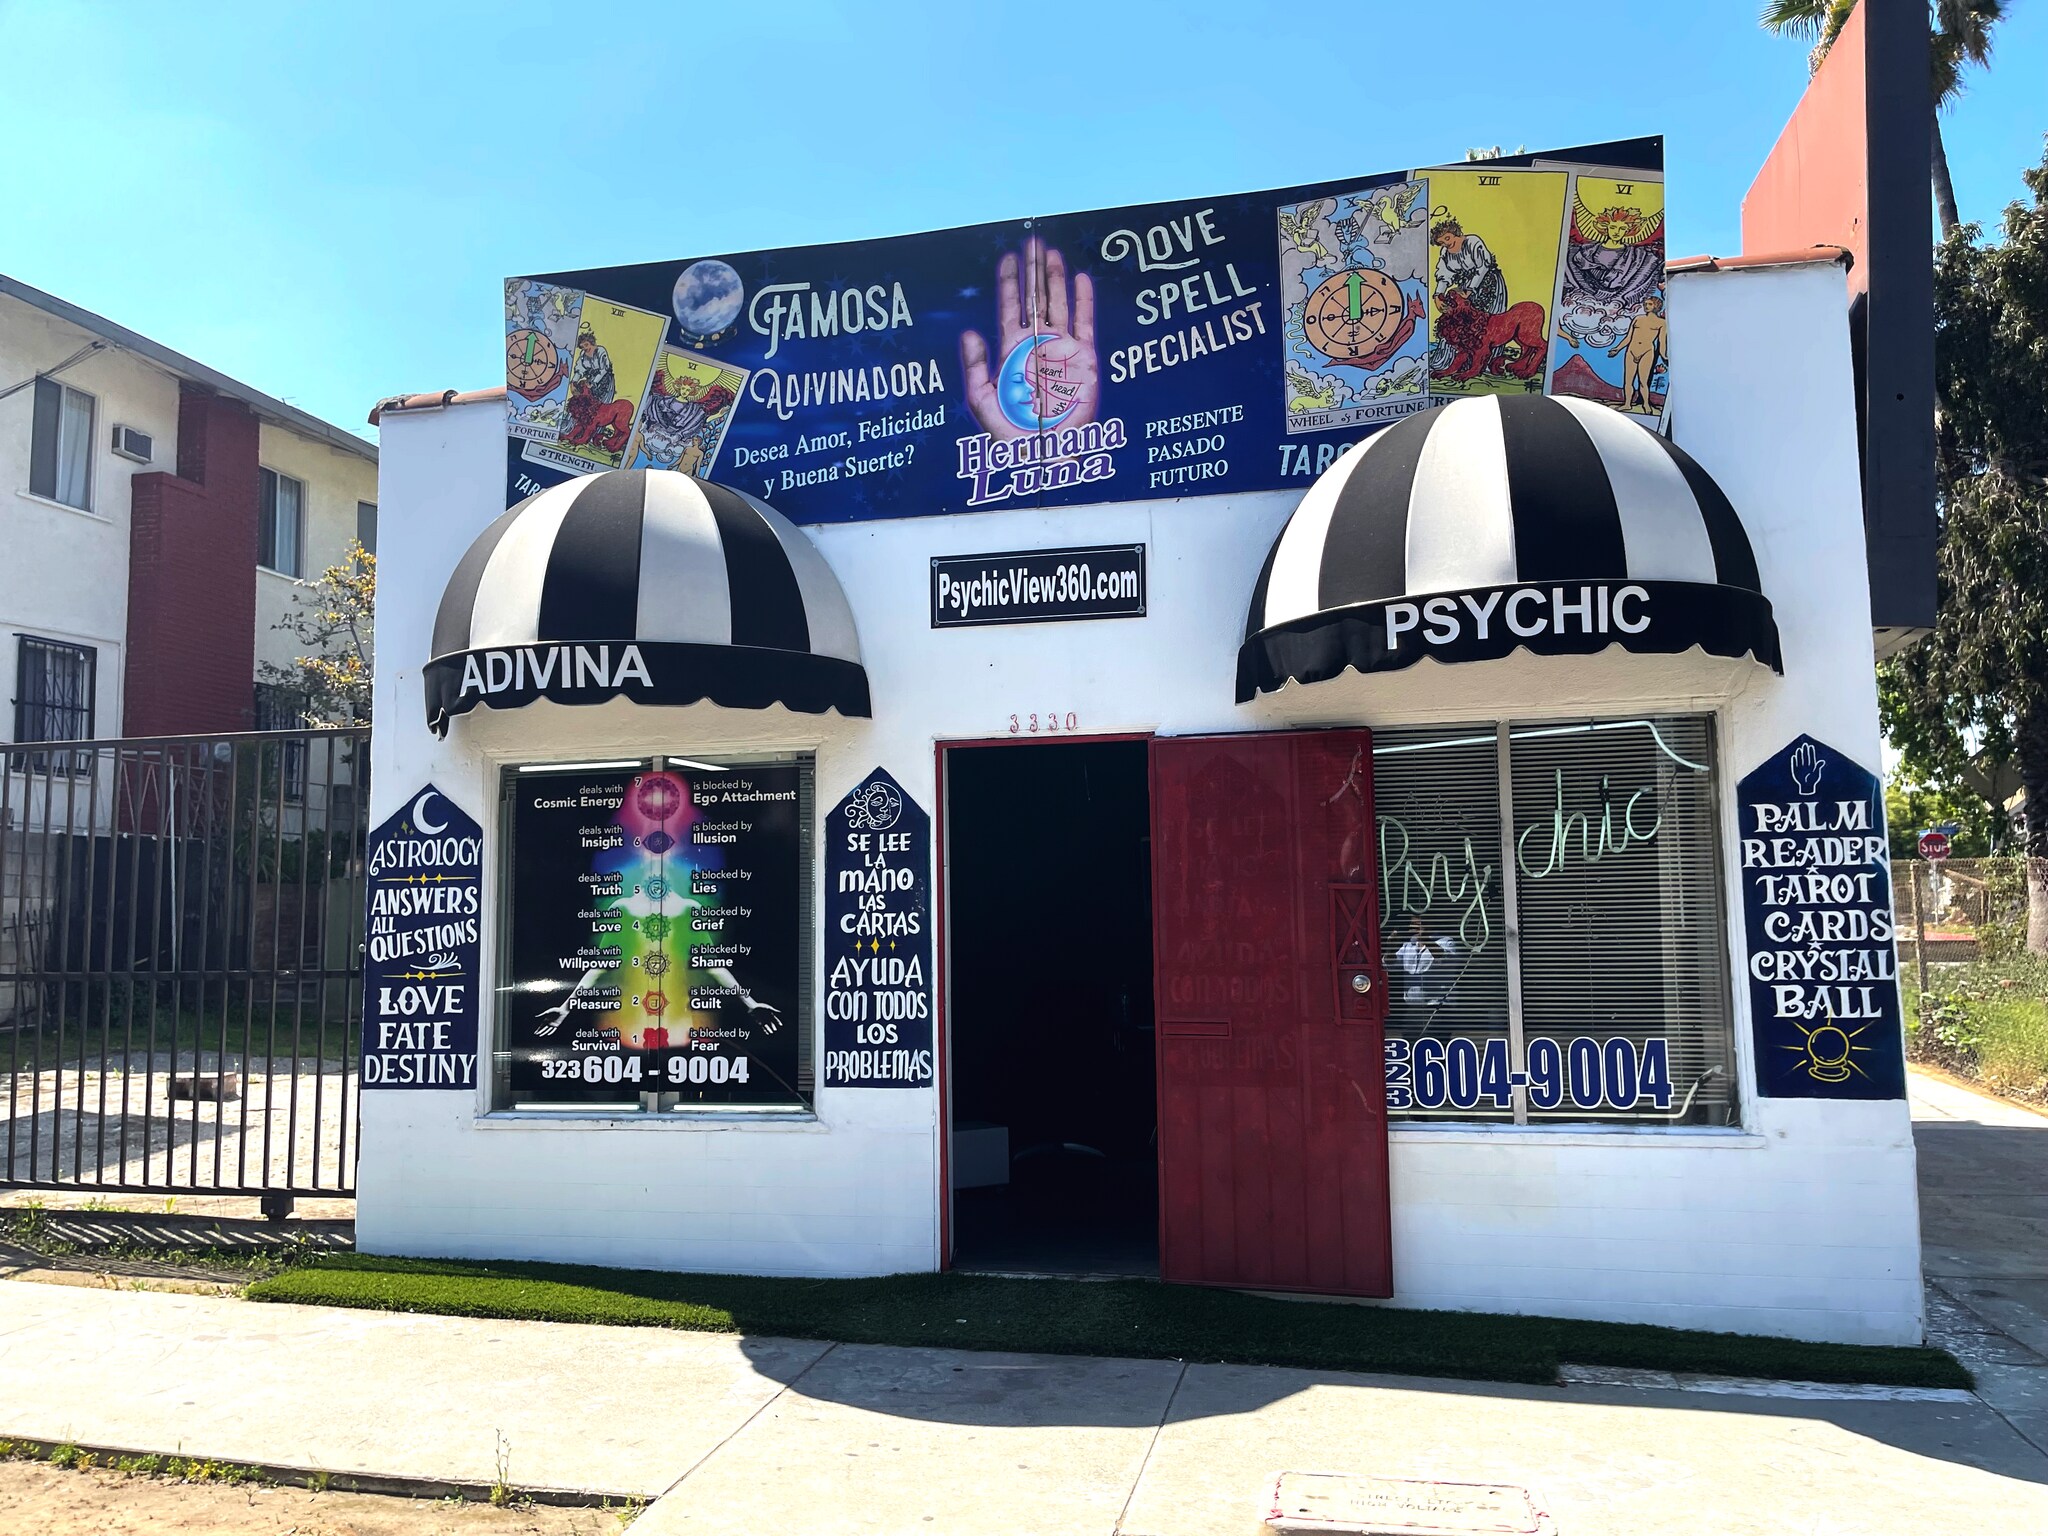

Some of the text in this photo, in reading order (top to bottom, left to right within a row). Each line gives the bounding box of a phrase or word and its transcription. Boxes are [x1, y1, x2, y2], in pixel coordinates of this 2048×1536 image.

[1101, 208, 1226, 272] LOVE
[1135, 263, 1257, 325] SPELL
[749, 281, 913, 359] FAMOSA
[1109, 302, 1267, 383] SPECIALIST
[750, 359, 944, 420] ADIVINADORA
[1145, 404, 1244, 439] PRESENTE
[1289, 415, 1333, 428] WHEEL
[734, 404, 945, 468] Desea Amor, Felicidad
[956, 417, 1128, 478] Hermana
[1148, 434, 1225, 464] PASADO
[764, 444, 915, 499] y Buena Suerte?
[967, 453, 1116, 506] Luna
[1149, 459, 1229, 489] FUTURO
[939, 563, 1138, 617] PsychicView360.com
[1384, 584, 1652, 650] PSYCHIC
[460, 644, 654, 697] ADIVINA
[1009, 712, 1077, 733] 3330
[579, 784, 623, 794] deals with
[693, 780, 753, 791] is blocked by
[534, 796, 623, 809] Cosmic Energy
[693, 789, 797, 806] Ego Attachment
[693, 820, 753, 832] is blocked by
[1750, 800, 1872, 832] PALM
[578, 825, 623, 835] deals with
[693, 833, 737, 844] Illusion
[582, 836, 623, 849] Insight
[847, 832, 912, 852] SE LEE
[370, 837, 483, 877] ASTROLOGY
[865, 853, 886, 868] LA
[1743, 836, 1889, 869] READER
[578, 873, 622, 883] deals with
[692, 869, 752, 880] is blocked by
[590, 884, 622, 896] Truth
[692, 883, 717, 894] Lies
[1755, 872, 1878, 905] TAROT
[371, 886, 478, 917] ANSWERS
[858, 894, 886, 912] LAS
[577, 908, 622, 919] deals with
[691, 906, 752, 918] is blocked by
[371, 916, 397, 935] ALL
[592, 922, 622, 932] Love
[692, 918, 725, 930] Grief
[840, 911, 920, 938] CARTAS
[1764, 908, 1894, 943] CARDS
[370, 918, 478, 963] QUESTIONS
[691, 944, 752, 955] is blocked by
[577, 946, 622, 956] deals with
[559, 958, 622, 971] Willpower
[691, 956, 734, 968] Shame
[830, 954, 923, 989] AYUDA
[1750, 948, 1895, 982] CRYSTAL
[379, 985, 465, 1016] LOVE
[576, 986, 621, 996] deals with
[691, 985, 751, 997] is blocked by
[569, 998, 621, 1010] Pleasure
[691, 998, 722, 1009] Guilt
[873, 990, 928, 1021] TODOS
[1770, 984, 1882, 1019] BALL
[377, 1021, 452, 1050] FATE
[575, 1028, 621, 1038] deals with
[690, 1027, 751, 1040] is blocked by
[857, 1023, 898, 1045] LOS
[572, 1039, 621, 1051] Survival
[691, 1040, 720, 1051] Fear
[365, 1053, 477, 1084] DESTINY
[541, 1060, 581, 1079] 323
[826, 1048, 932, 1083] PROBLEMAS
